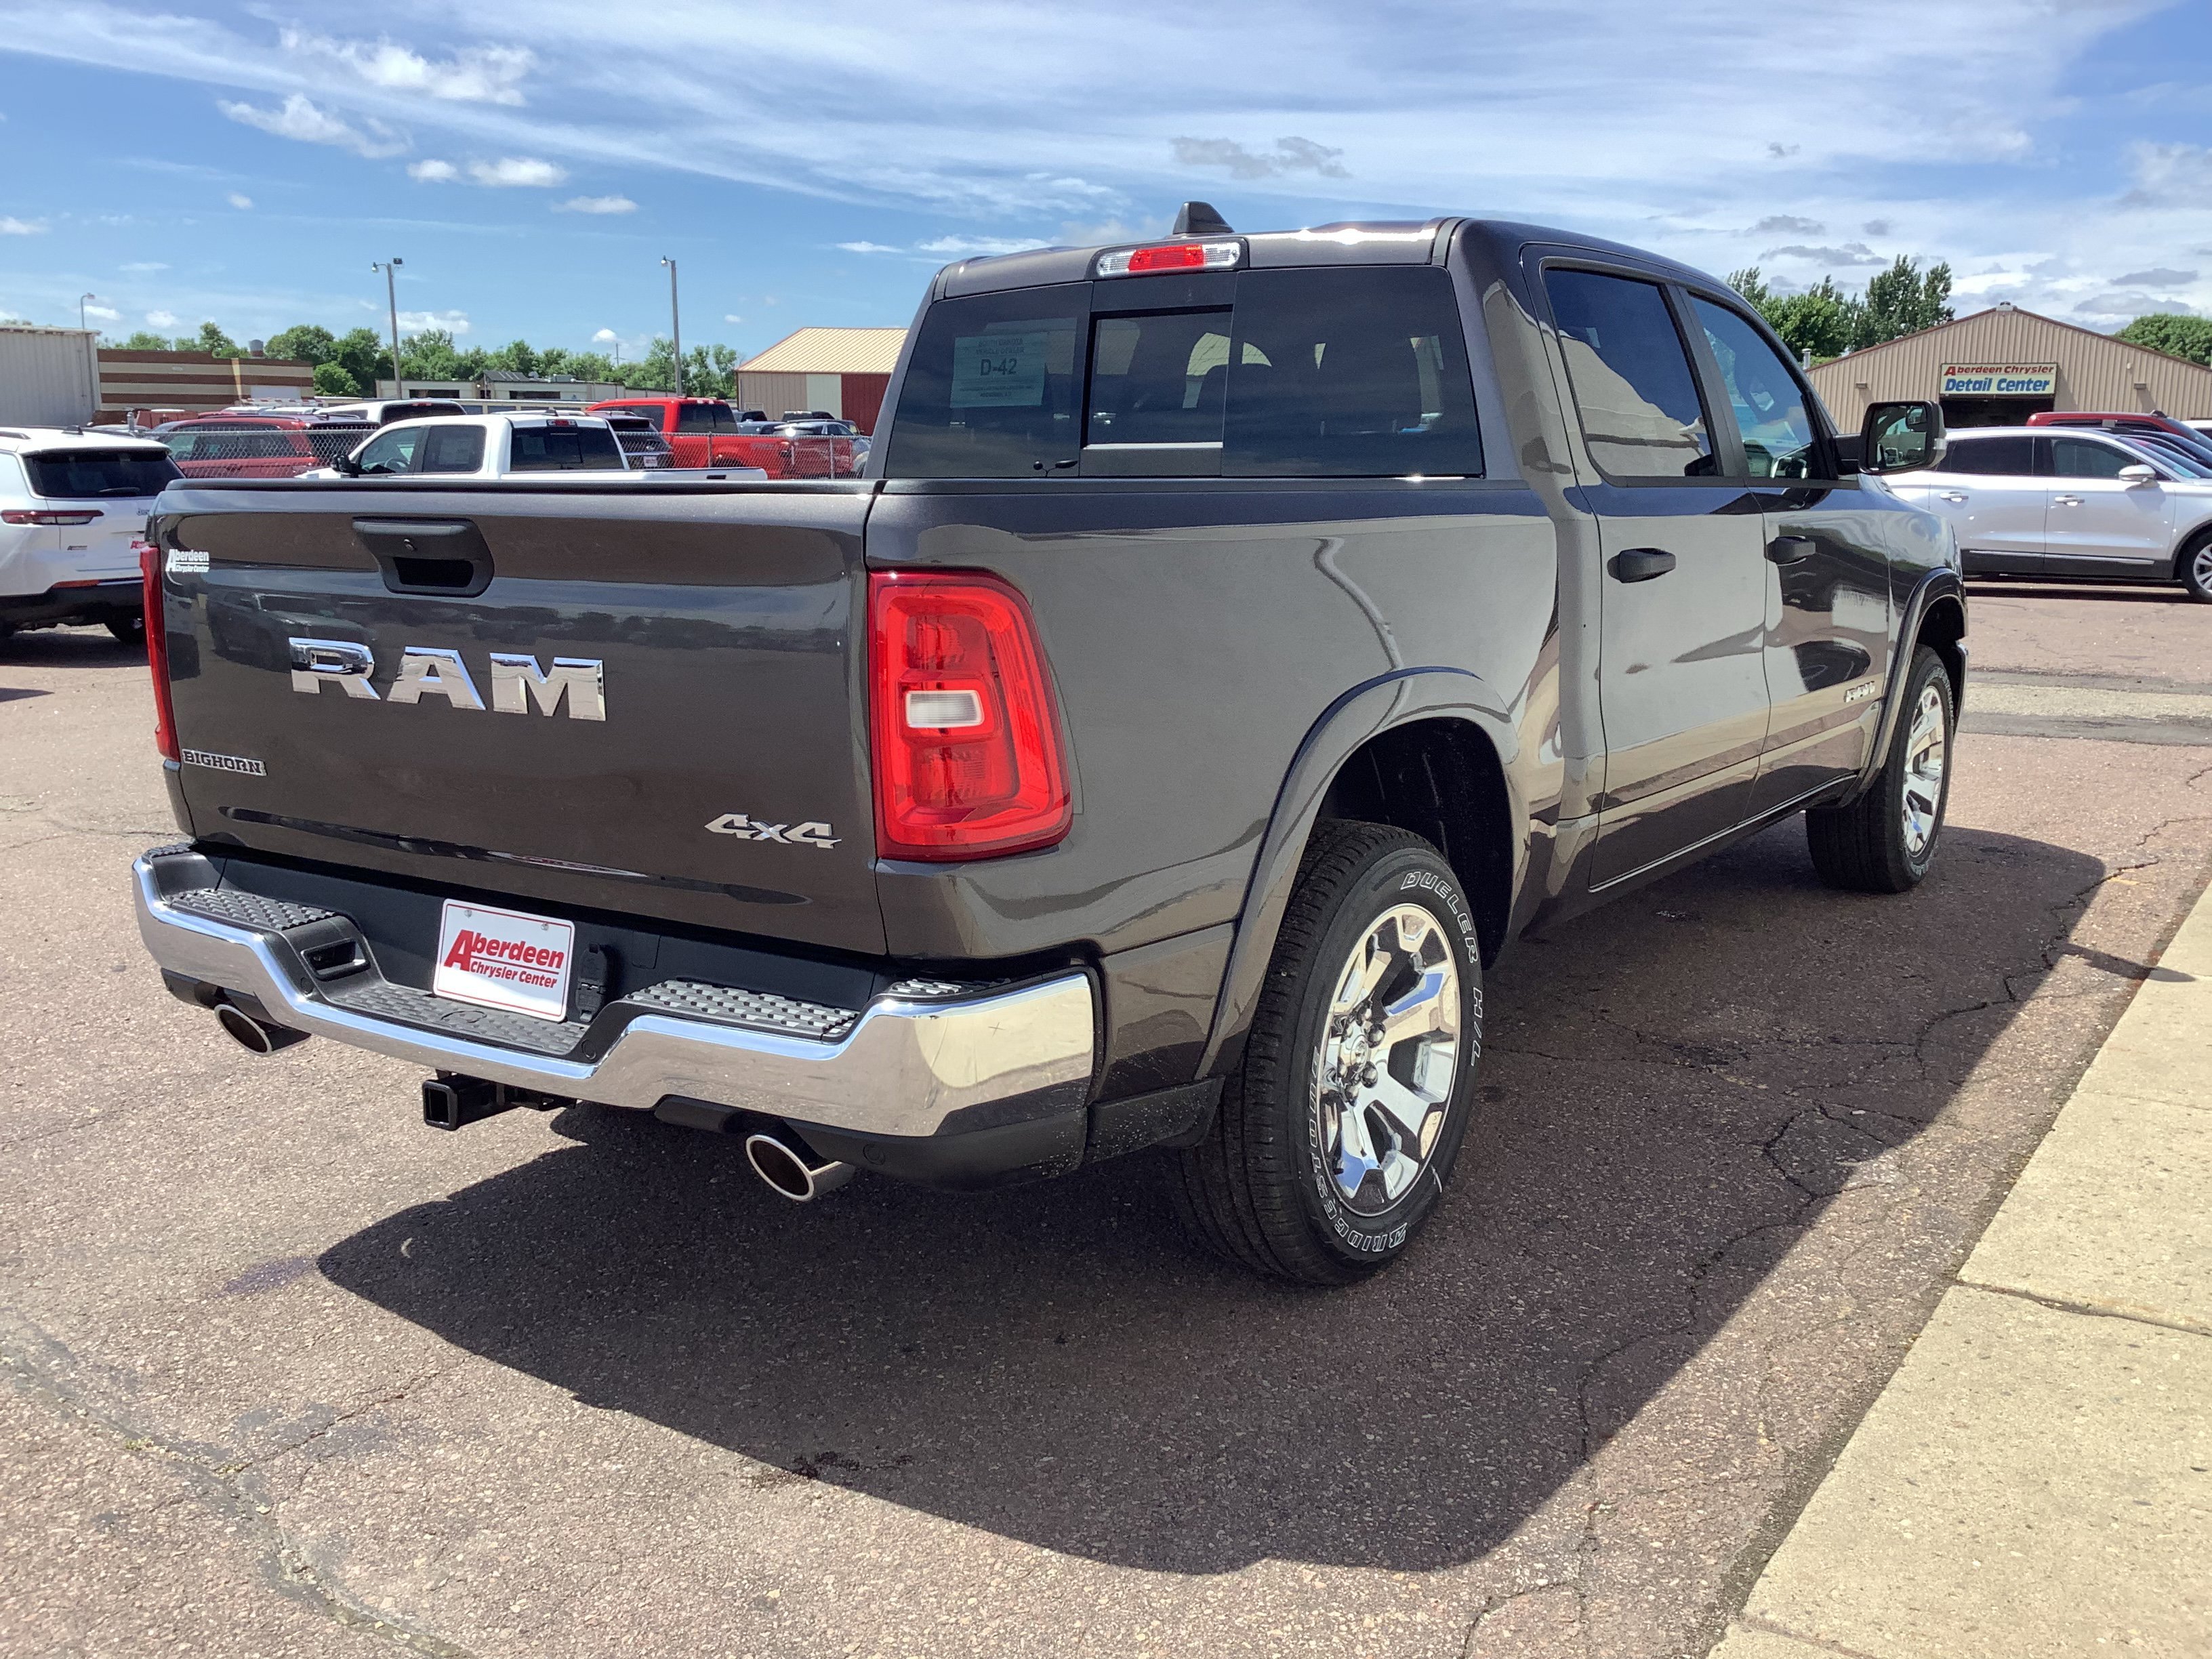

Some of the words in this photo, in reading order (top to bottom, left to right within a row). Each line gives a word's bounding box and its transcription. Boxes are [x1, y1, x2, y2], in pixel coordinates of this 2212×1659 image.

[980, 358, 1017, 375] D-42
[1944, 366, 2002, 375] Aberdeen
[2004, 365, 2054, 374] Chrysler
[1945, 378, 1992, 391] Detail
[1996, 378, 2050, 392] Center
[165, 549, 209, 572] Aberdeen
[288, 636, 607, 721] RAM
[182, 749, 267, 776] BIGHORN
[1400, 871, 1479, 964] DUELER
[443, 929, 565, 972] Aberdeen
[470, 961, 517, 980] Chrysler
[518, 970, 558, 989] Center
[1309, 1046, 1408, 1252] BRIDGESTONE
